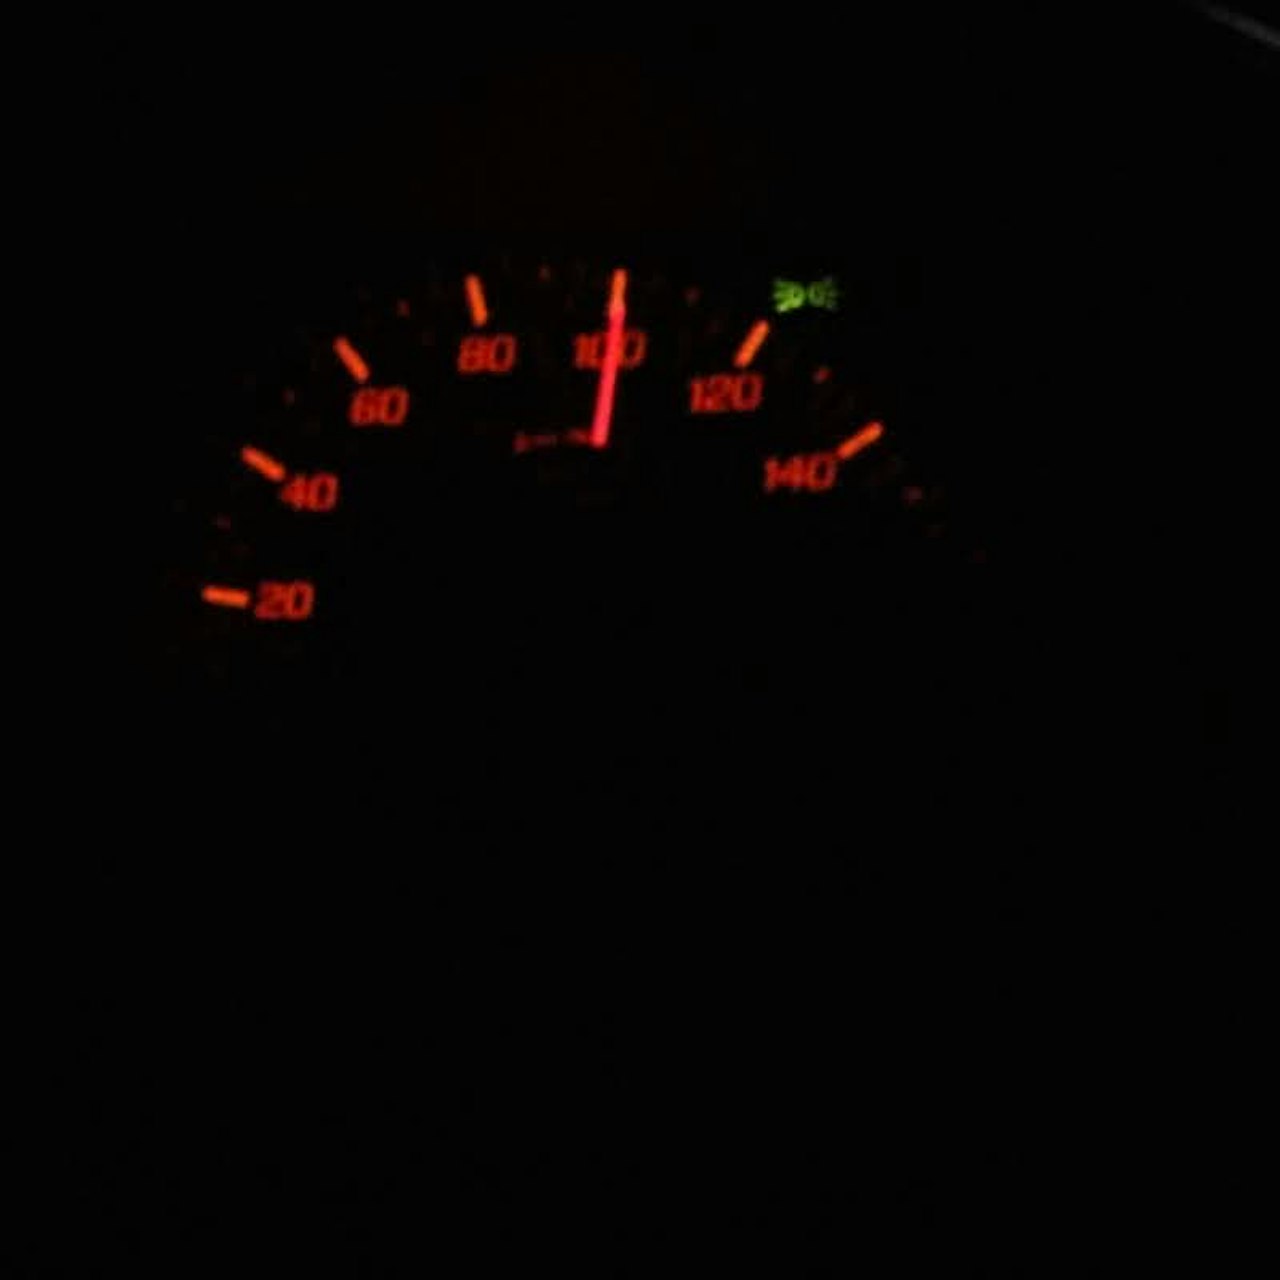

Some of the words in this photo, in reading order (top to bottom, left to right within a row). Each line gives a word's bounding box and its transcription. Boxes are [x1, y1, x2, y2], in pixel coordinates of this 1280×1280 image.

[456, 333, 519, 376] 80
[574, 331, 647, 371] 100
[348, 385, 411, 428] 60
[688, 372, 765, 415] 120
[280, 472, 340, 513] 40
[763, 452, 840, 496] 140
[254, 581, 317, 622] 20
